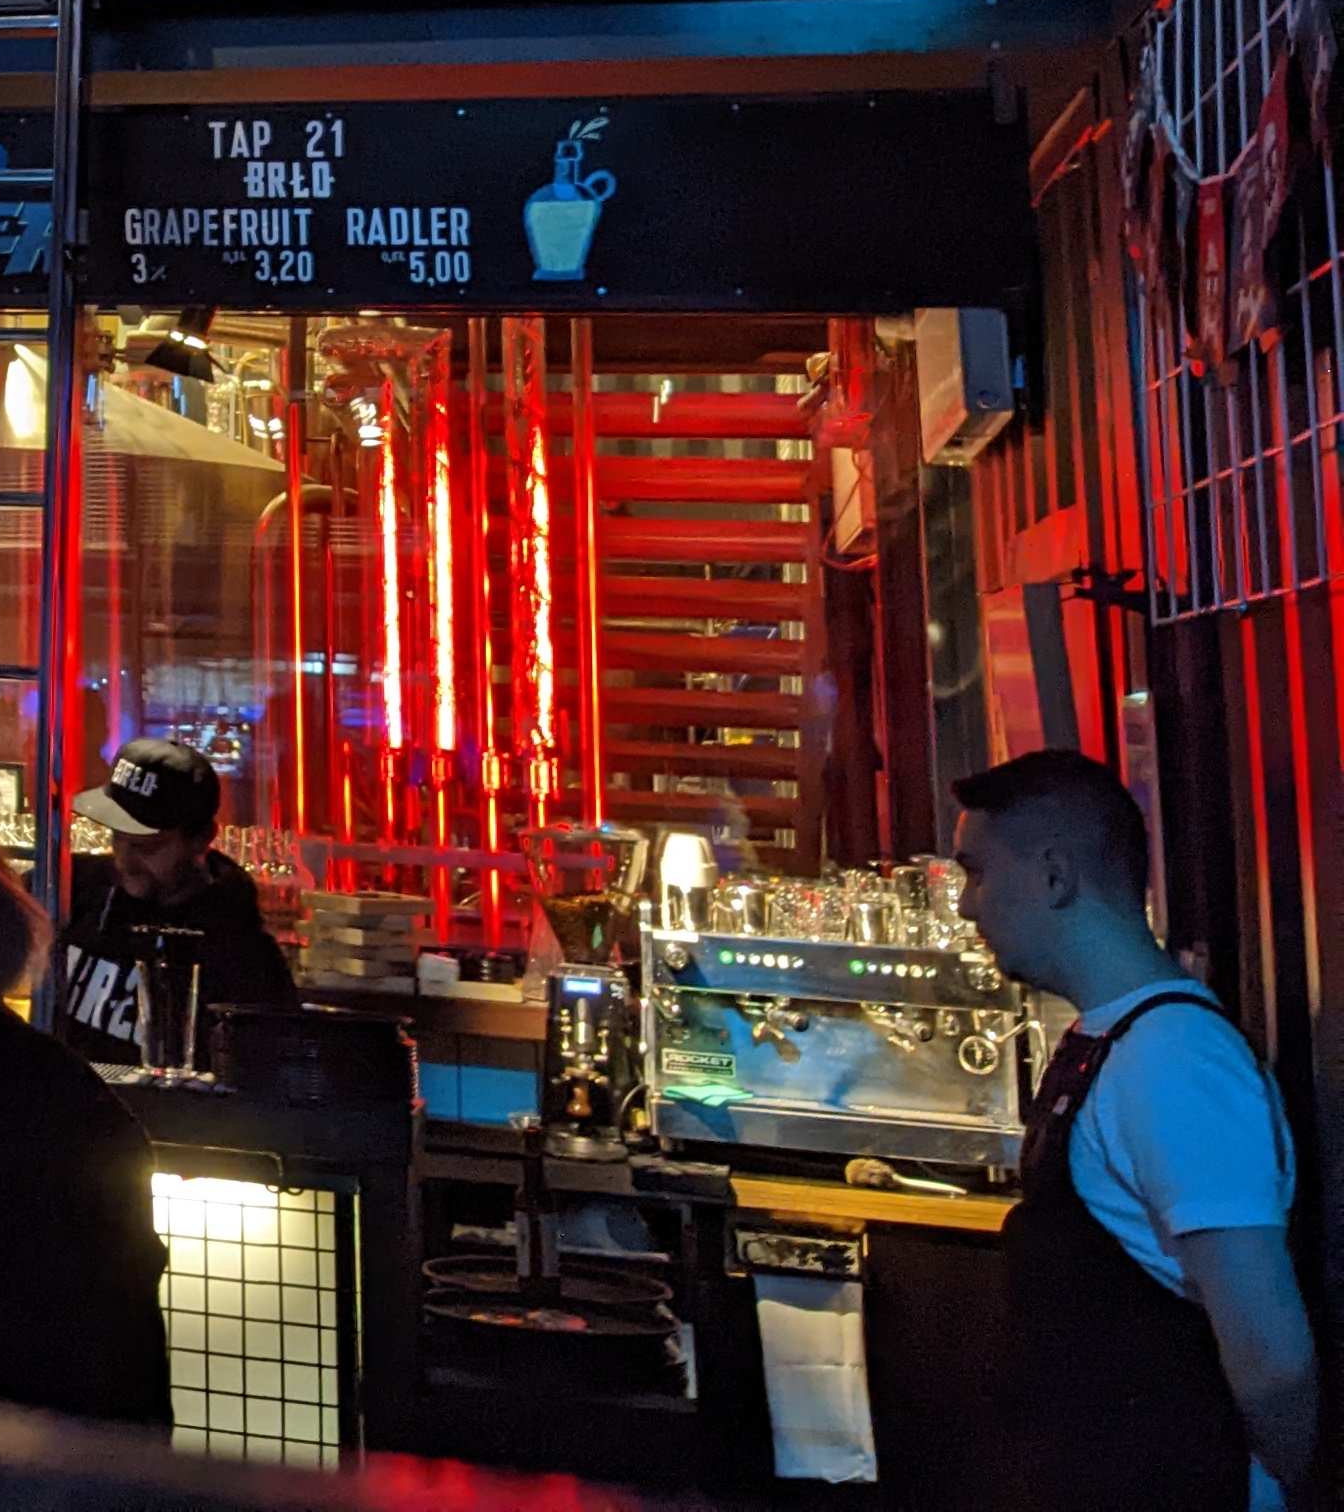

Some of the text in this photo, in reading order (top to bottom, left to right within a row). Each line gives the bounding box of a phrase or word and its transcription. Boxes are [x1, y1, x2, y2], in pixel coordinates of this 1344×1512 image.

[209, 120, 345, 159] TAP 21
[124, 207, 470, 246] GRAPEFRUIT RADLER
